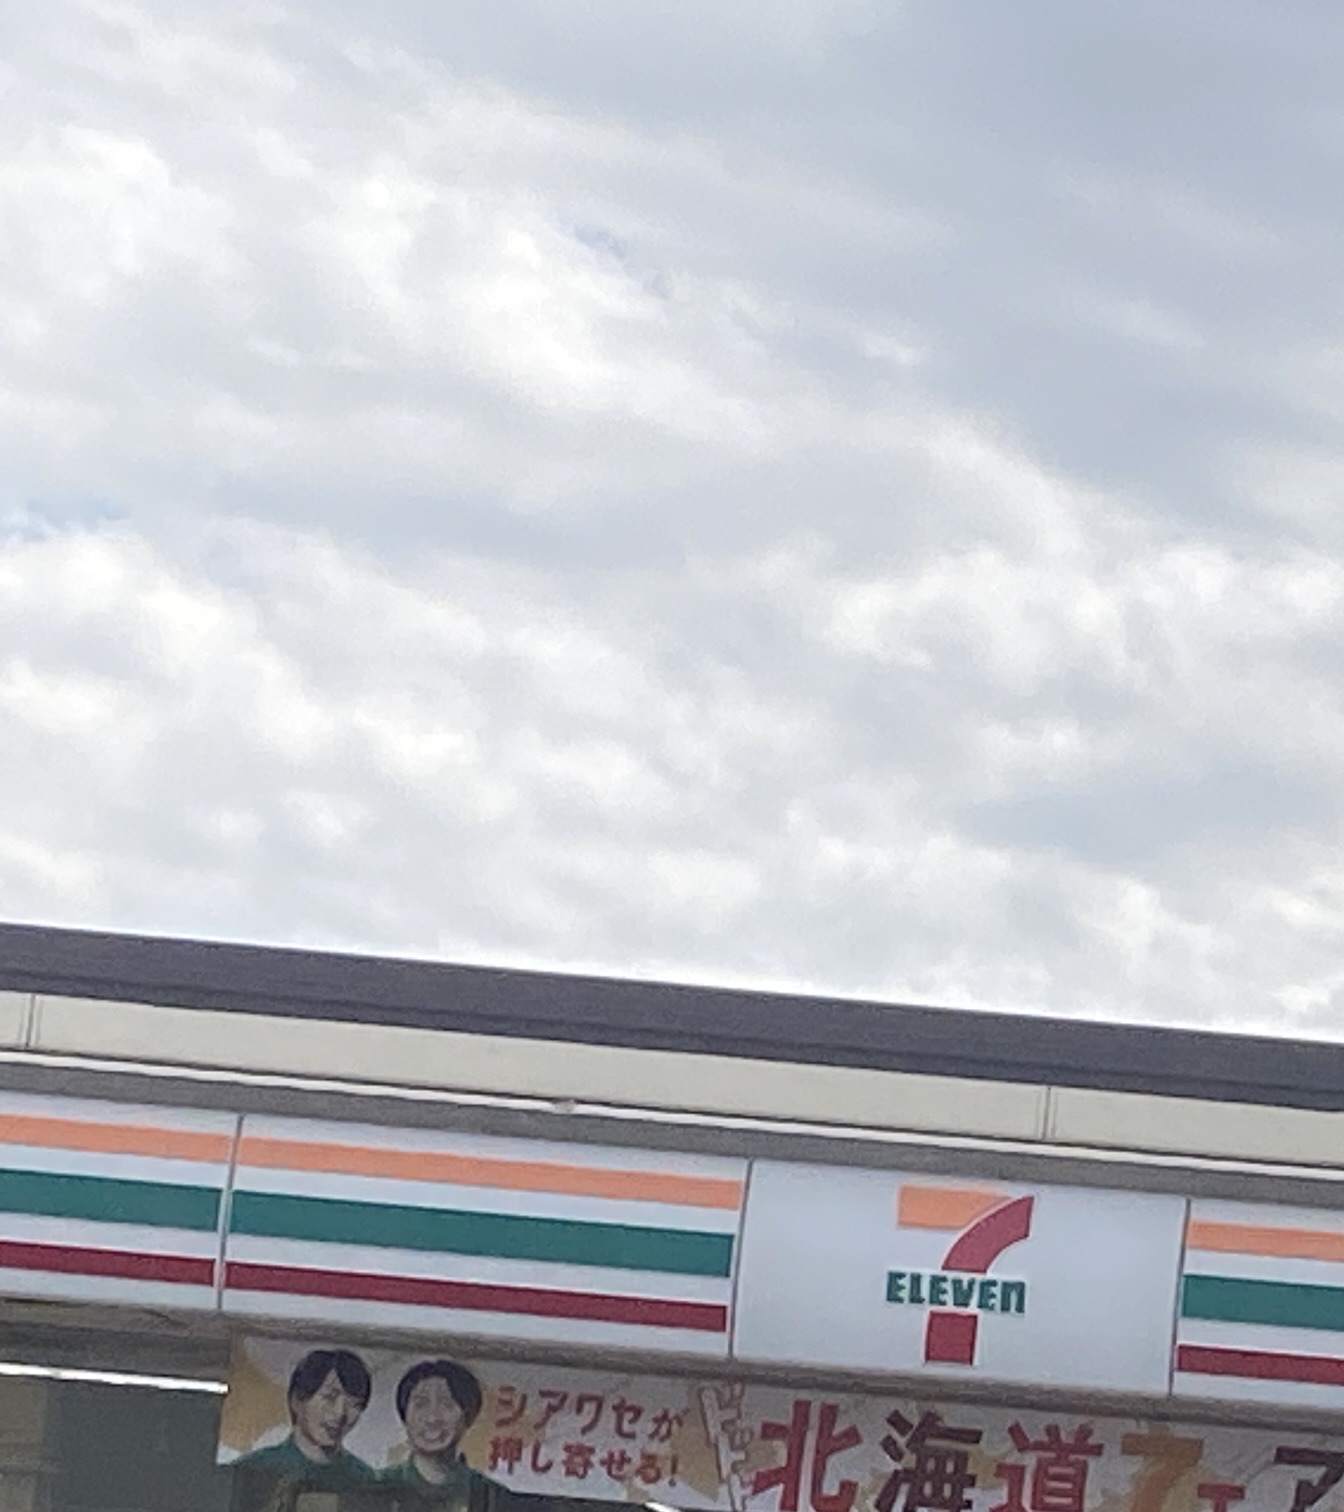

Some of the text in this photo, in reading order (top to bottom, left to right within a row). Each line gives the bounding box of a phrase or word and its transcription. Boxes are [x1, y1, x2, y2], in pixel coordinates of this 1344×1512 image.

[495, 1385, 689, 1442] シアワセが
